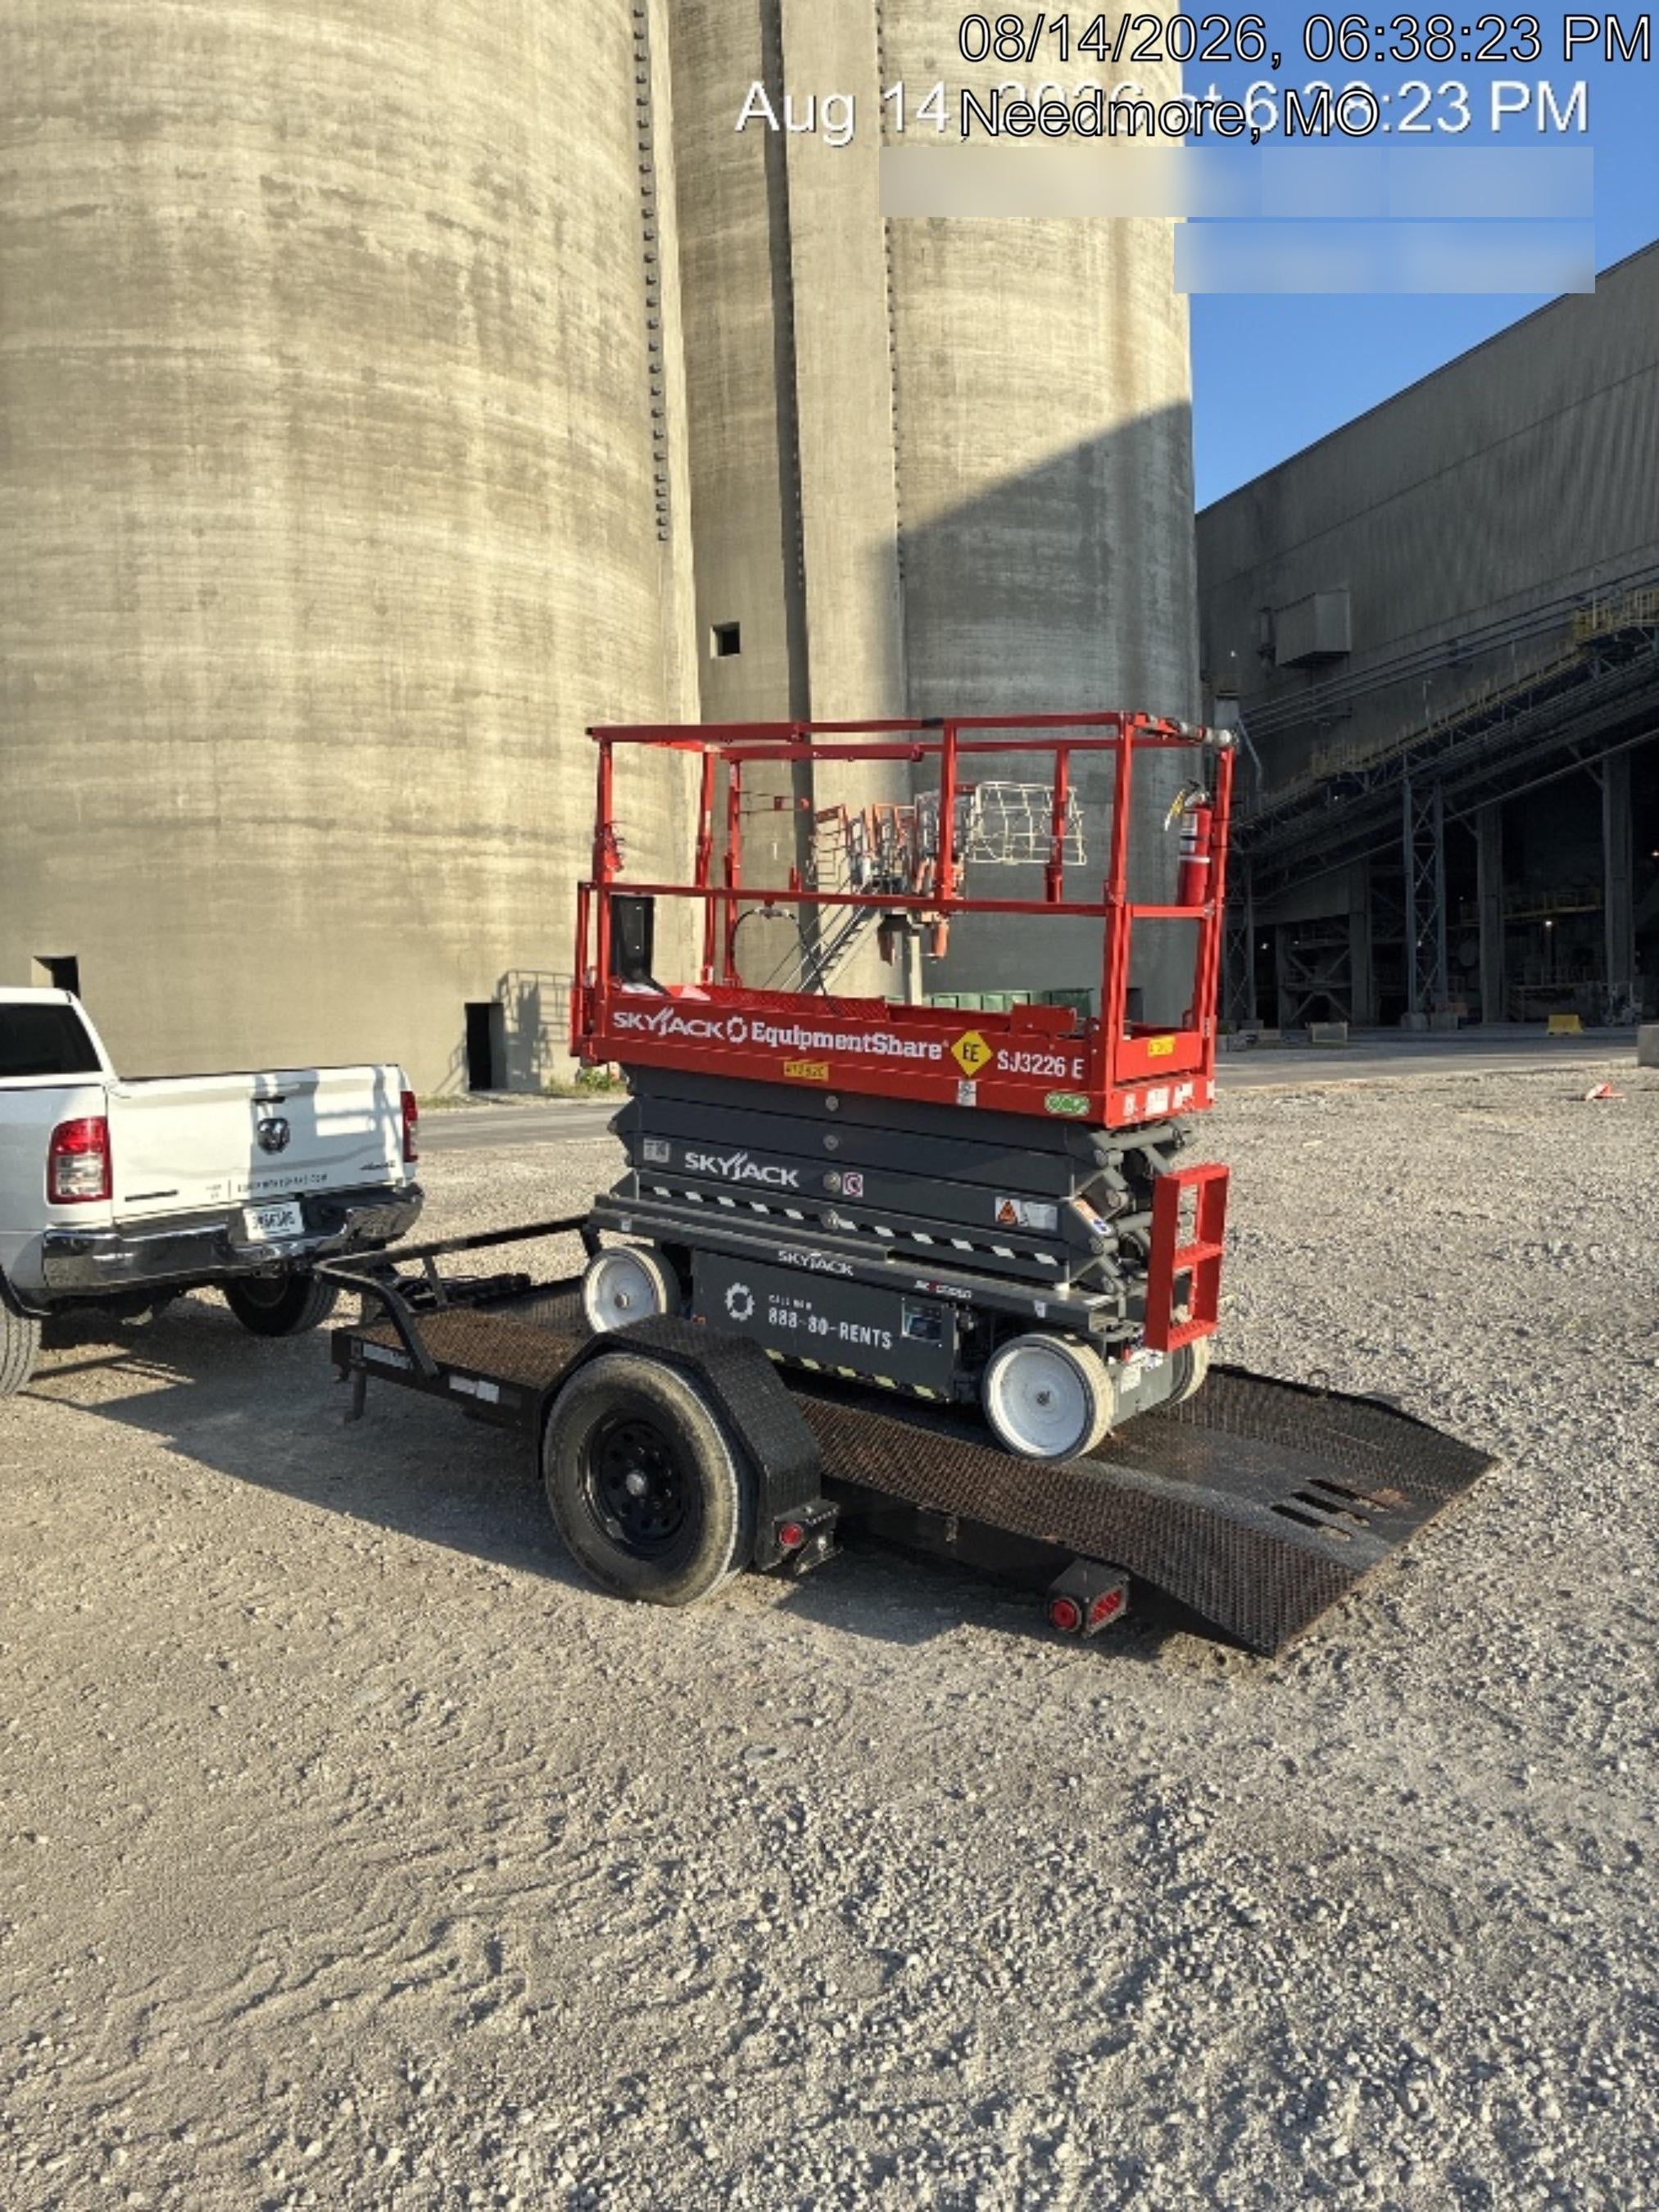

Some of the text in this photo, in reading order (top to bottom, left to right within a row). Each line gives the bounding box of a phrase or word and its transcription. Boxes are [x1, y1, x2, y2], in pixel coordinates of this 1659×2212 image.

[613, 1005, 726, 1040] SKYJACK
[750, 1021, 943, 1060] EquipmentShare
[997, 1049, 1086, 1081] SJ3226 E
[684, 1151, 800, 1189] SKYJACK
